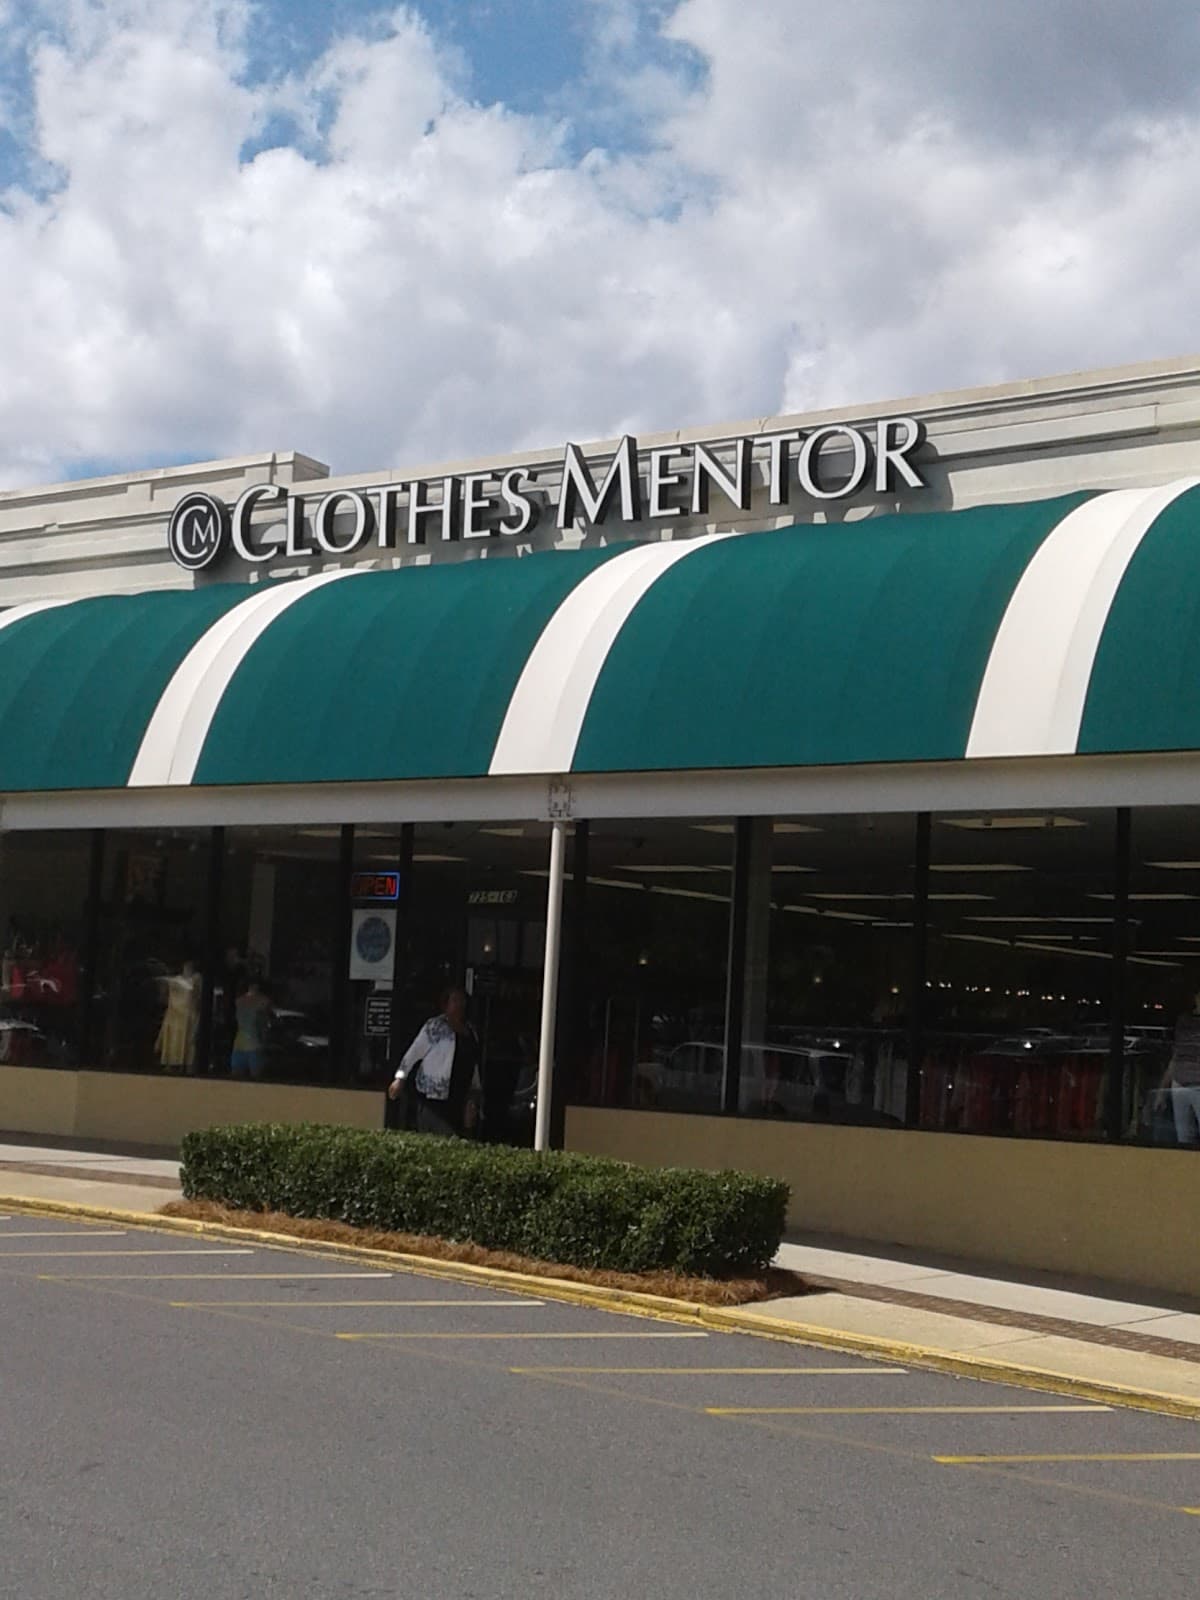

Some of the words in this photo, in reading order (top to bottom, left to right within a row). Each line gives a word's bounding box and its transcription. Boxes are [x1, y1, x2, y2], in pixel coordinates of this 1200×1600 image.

[176, 505, 215, 559] CM
[230, 467, 536, 562] CLOTHES
[556, 416, 925, 529] MENTOR
[352, 876, 397, 896] PEN
